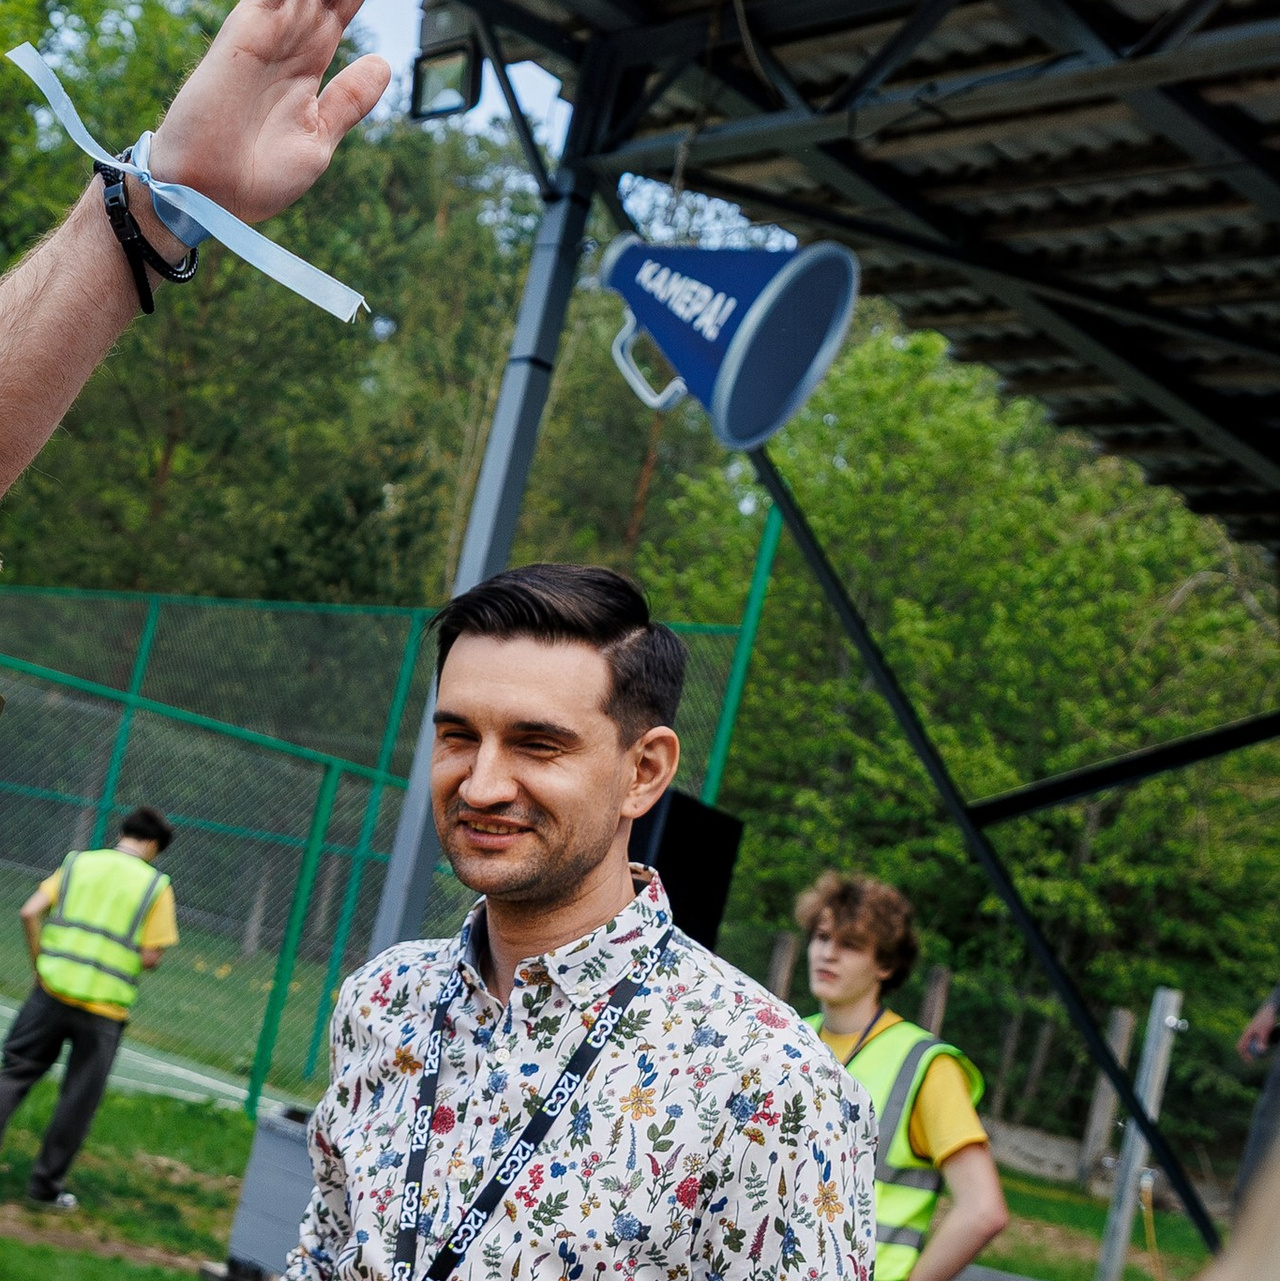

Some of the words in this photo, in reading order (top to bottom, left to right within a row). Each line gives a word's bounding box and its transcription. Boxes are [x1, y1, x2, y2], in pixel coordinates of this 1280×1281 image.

[587, 1004, 623, 1049] 1200
[424, 1030, 442, 1078] 1200
[542, 1071, 580, 1117] 1200
[412, 1105, 432, 1152] 1200
[496, 1140, 535, 1185] 1200
[400, 1181, 420, 1231] 1200
[448, 1208, 487, 1254] 1200
